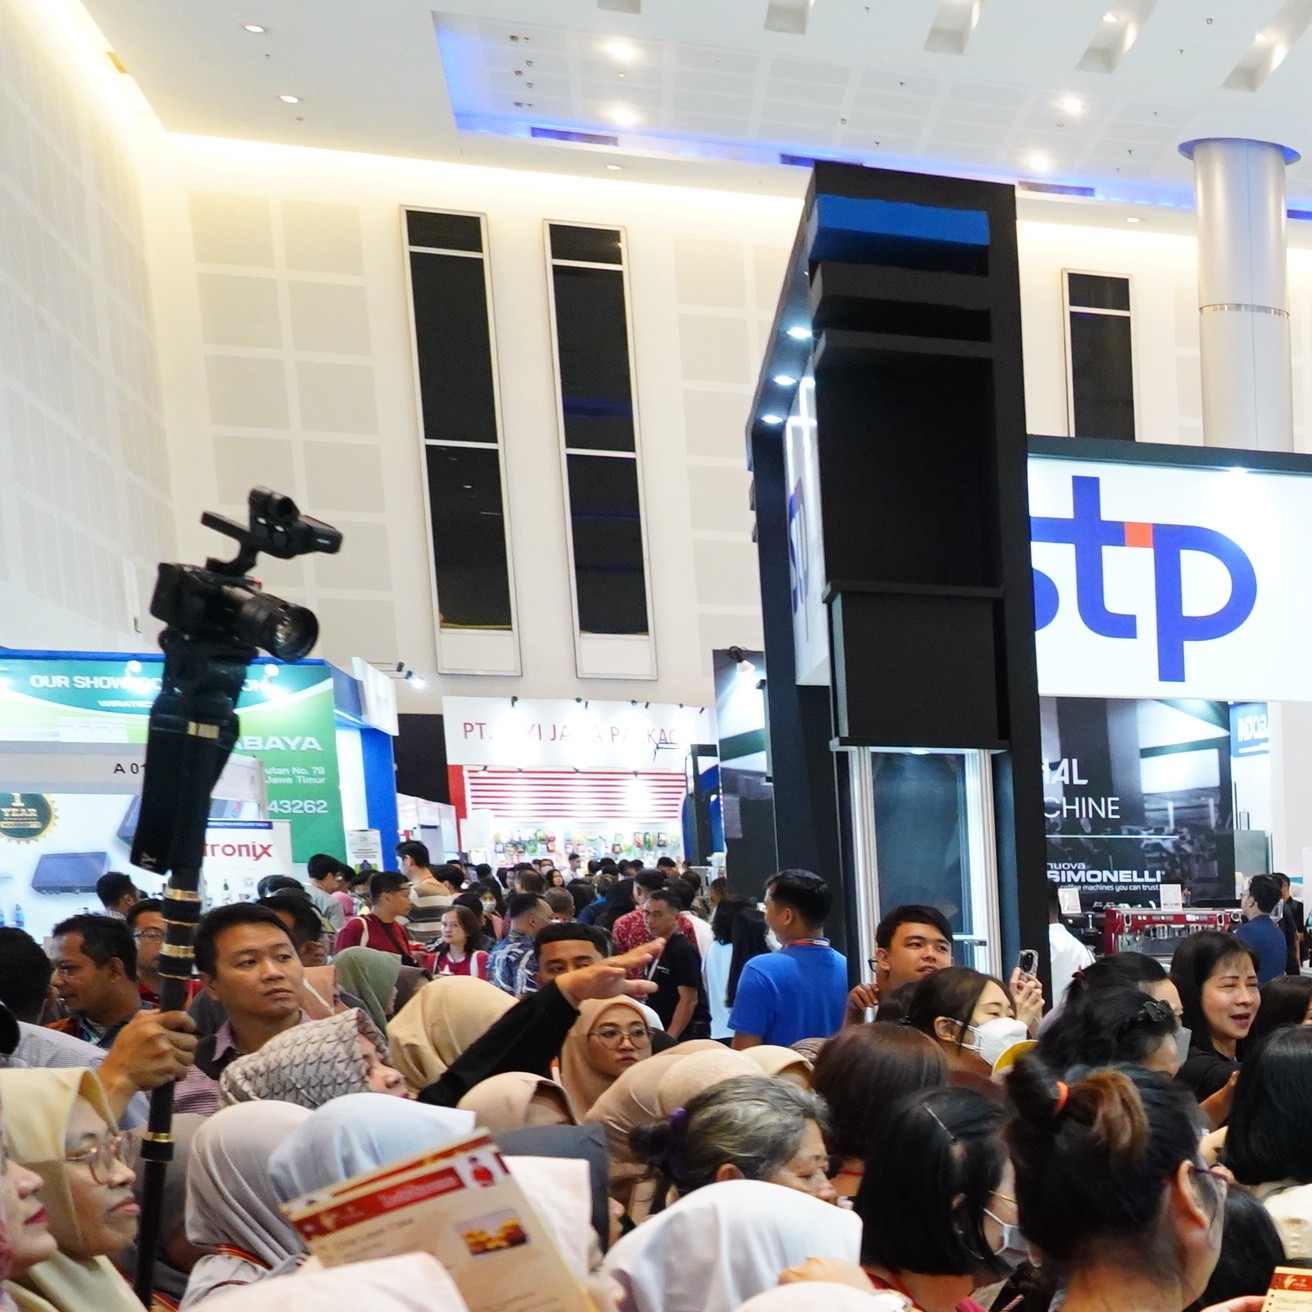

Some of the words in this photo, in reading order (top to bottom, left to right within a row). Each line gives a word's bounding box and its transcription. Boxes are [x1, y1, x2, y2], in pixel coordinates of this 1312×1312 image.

[29, 674, 71, 689] OUR
[462, 721, 493, 740] PT.
[234, 735, 323, 751] BAYA
[113, 763, 126, 774] A
[265, 767, 290, 776] utan
[292, 767, 310, 776] No.
[265, 775, 293, 785] Jawa
[297, 775, 326, 785] Timur
[268, 800, 328, 814] 43262
[1043, 796, 1121, 819] CHINE
[203, 840, 273, 862] tronix
[1046, 869, 1163, 884] SIMONELLI
[1083, 883, 1114, 892] machines
[1115, 885, 1128, 893] you
[1142, 884, 1160, 892] trust
